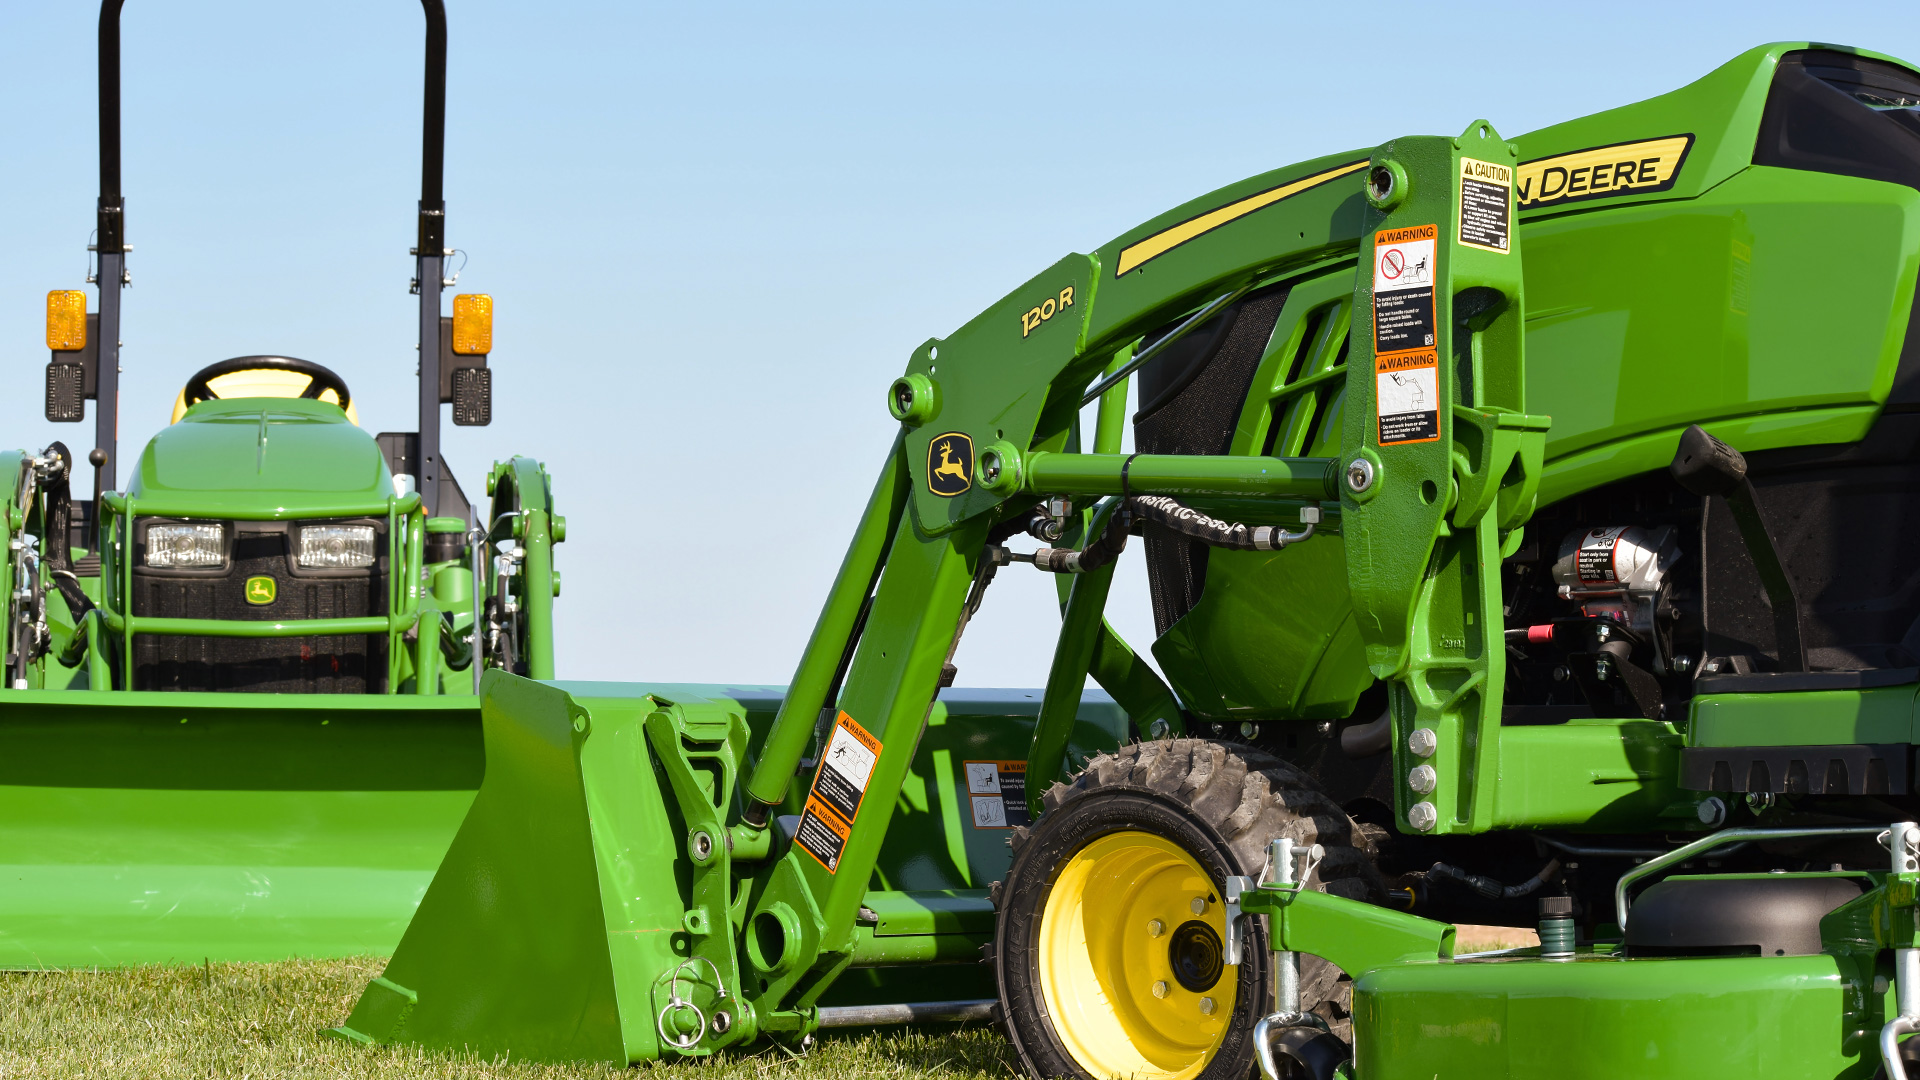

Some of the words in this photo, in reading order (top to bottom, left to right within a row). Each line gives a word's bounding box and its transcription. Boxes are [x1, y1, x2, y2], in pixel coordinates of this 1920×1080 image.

[1475, 163, 1509, 182] CAUTION
[1539, 157, 1661, 199] DEERE
[1387, 227, 1433, 242] WARNING
[1021, 297, 1056, 339] 120
[1059, 286, 1075, 313] R
[1388, 354, 1434, 368] WARNING
[850, 722, 876, 750] WARNING
[819, 808, 845, 836] WARNING
